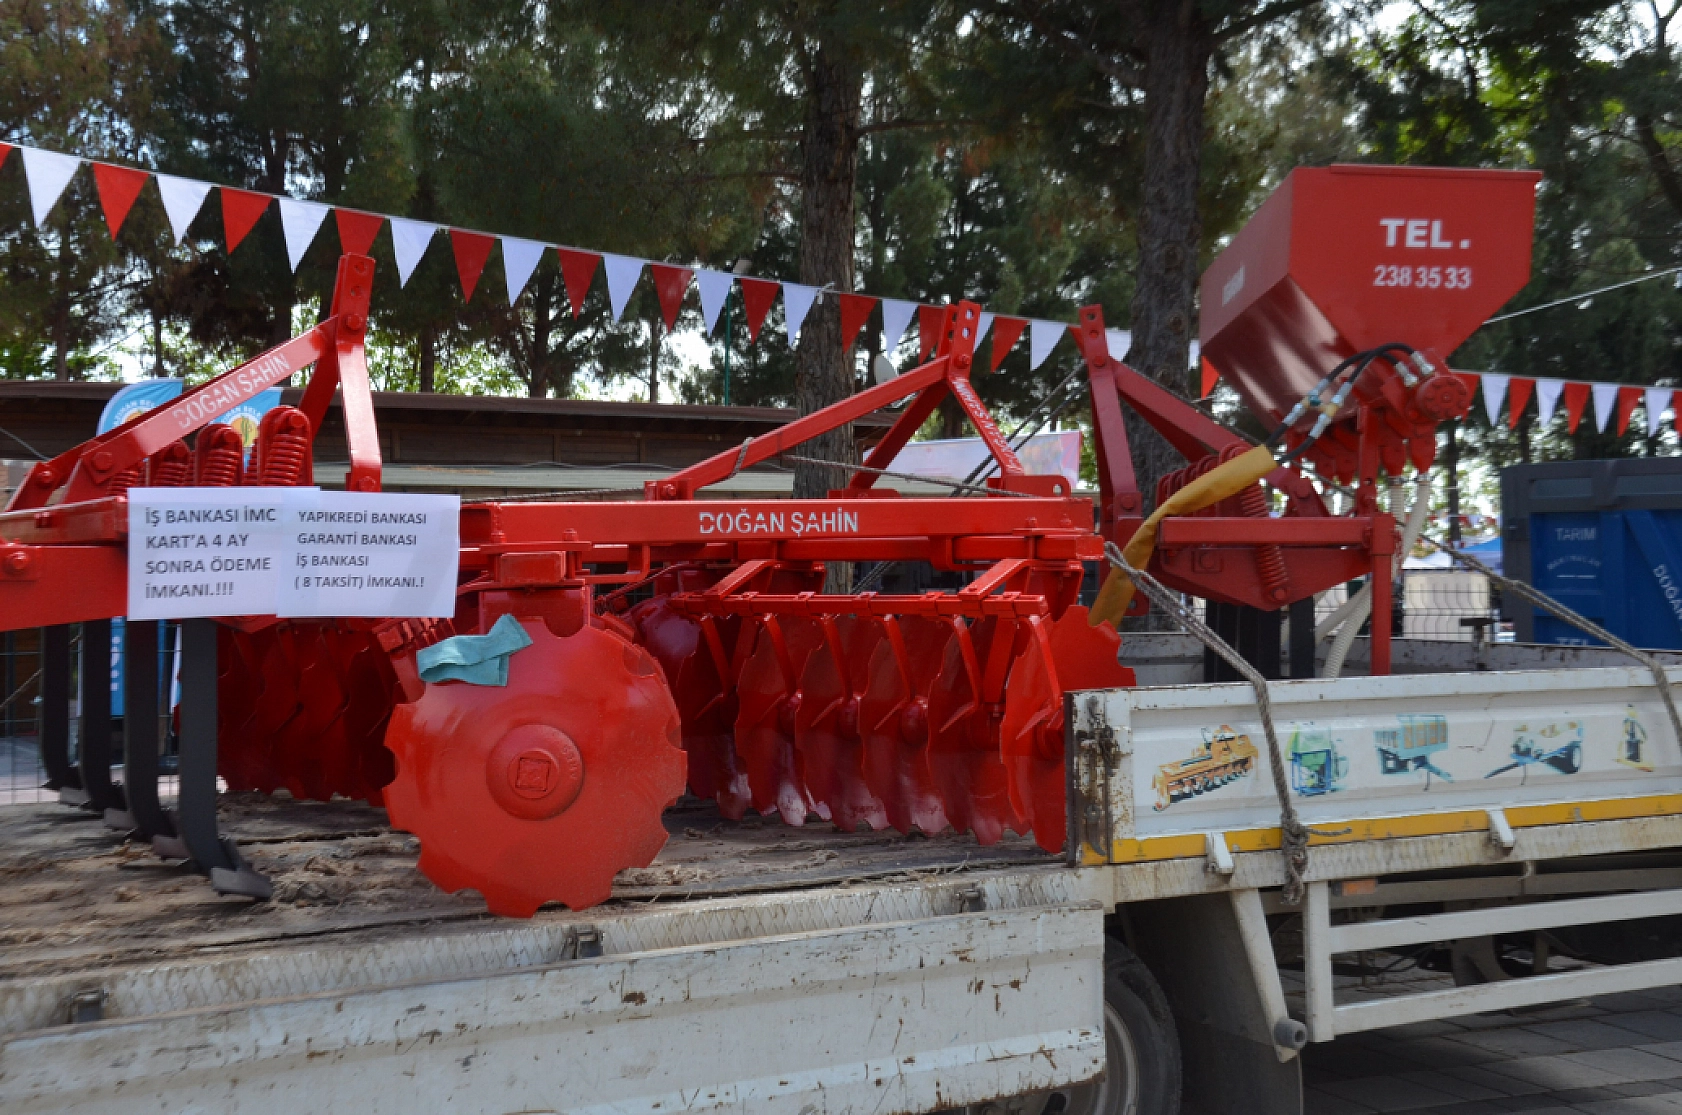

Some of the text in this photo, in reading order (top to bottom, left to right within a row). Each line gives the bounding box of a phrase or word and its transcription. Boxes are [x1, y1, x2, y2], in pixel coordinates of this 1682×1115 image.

[1373, 263, 1472, 290] 238 35 33
[145, 505, 276, 527] İŞ BANKASI İMC
[298, 510, 427, 525] YAPIKREDİ BANKASI
[698, 506, 859, 537] DOĞAN ŞAHİN
[146, 533, 249, 549] KART'A 4 AY
[297, 531, 417, 546] GARANTİ BANKASI
[1555, 527, 1597, 541] TARIM
[145, 555, 272, 574] SONRA ÖDEME
[296, 552, 369, 569] İŞ BANKASI
[145, 582, 234, 599] İMKANI.!!!
[314, 574, 364, 590] TAKSİT)
[366, 574, 425, 588] İMKANI.!
